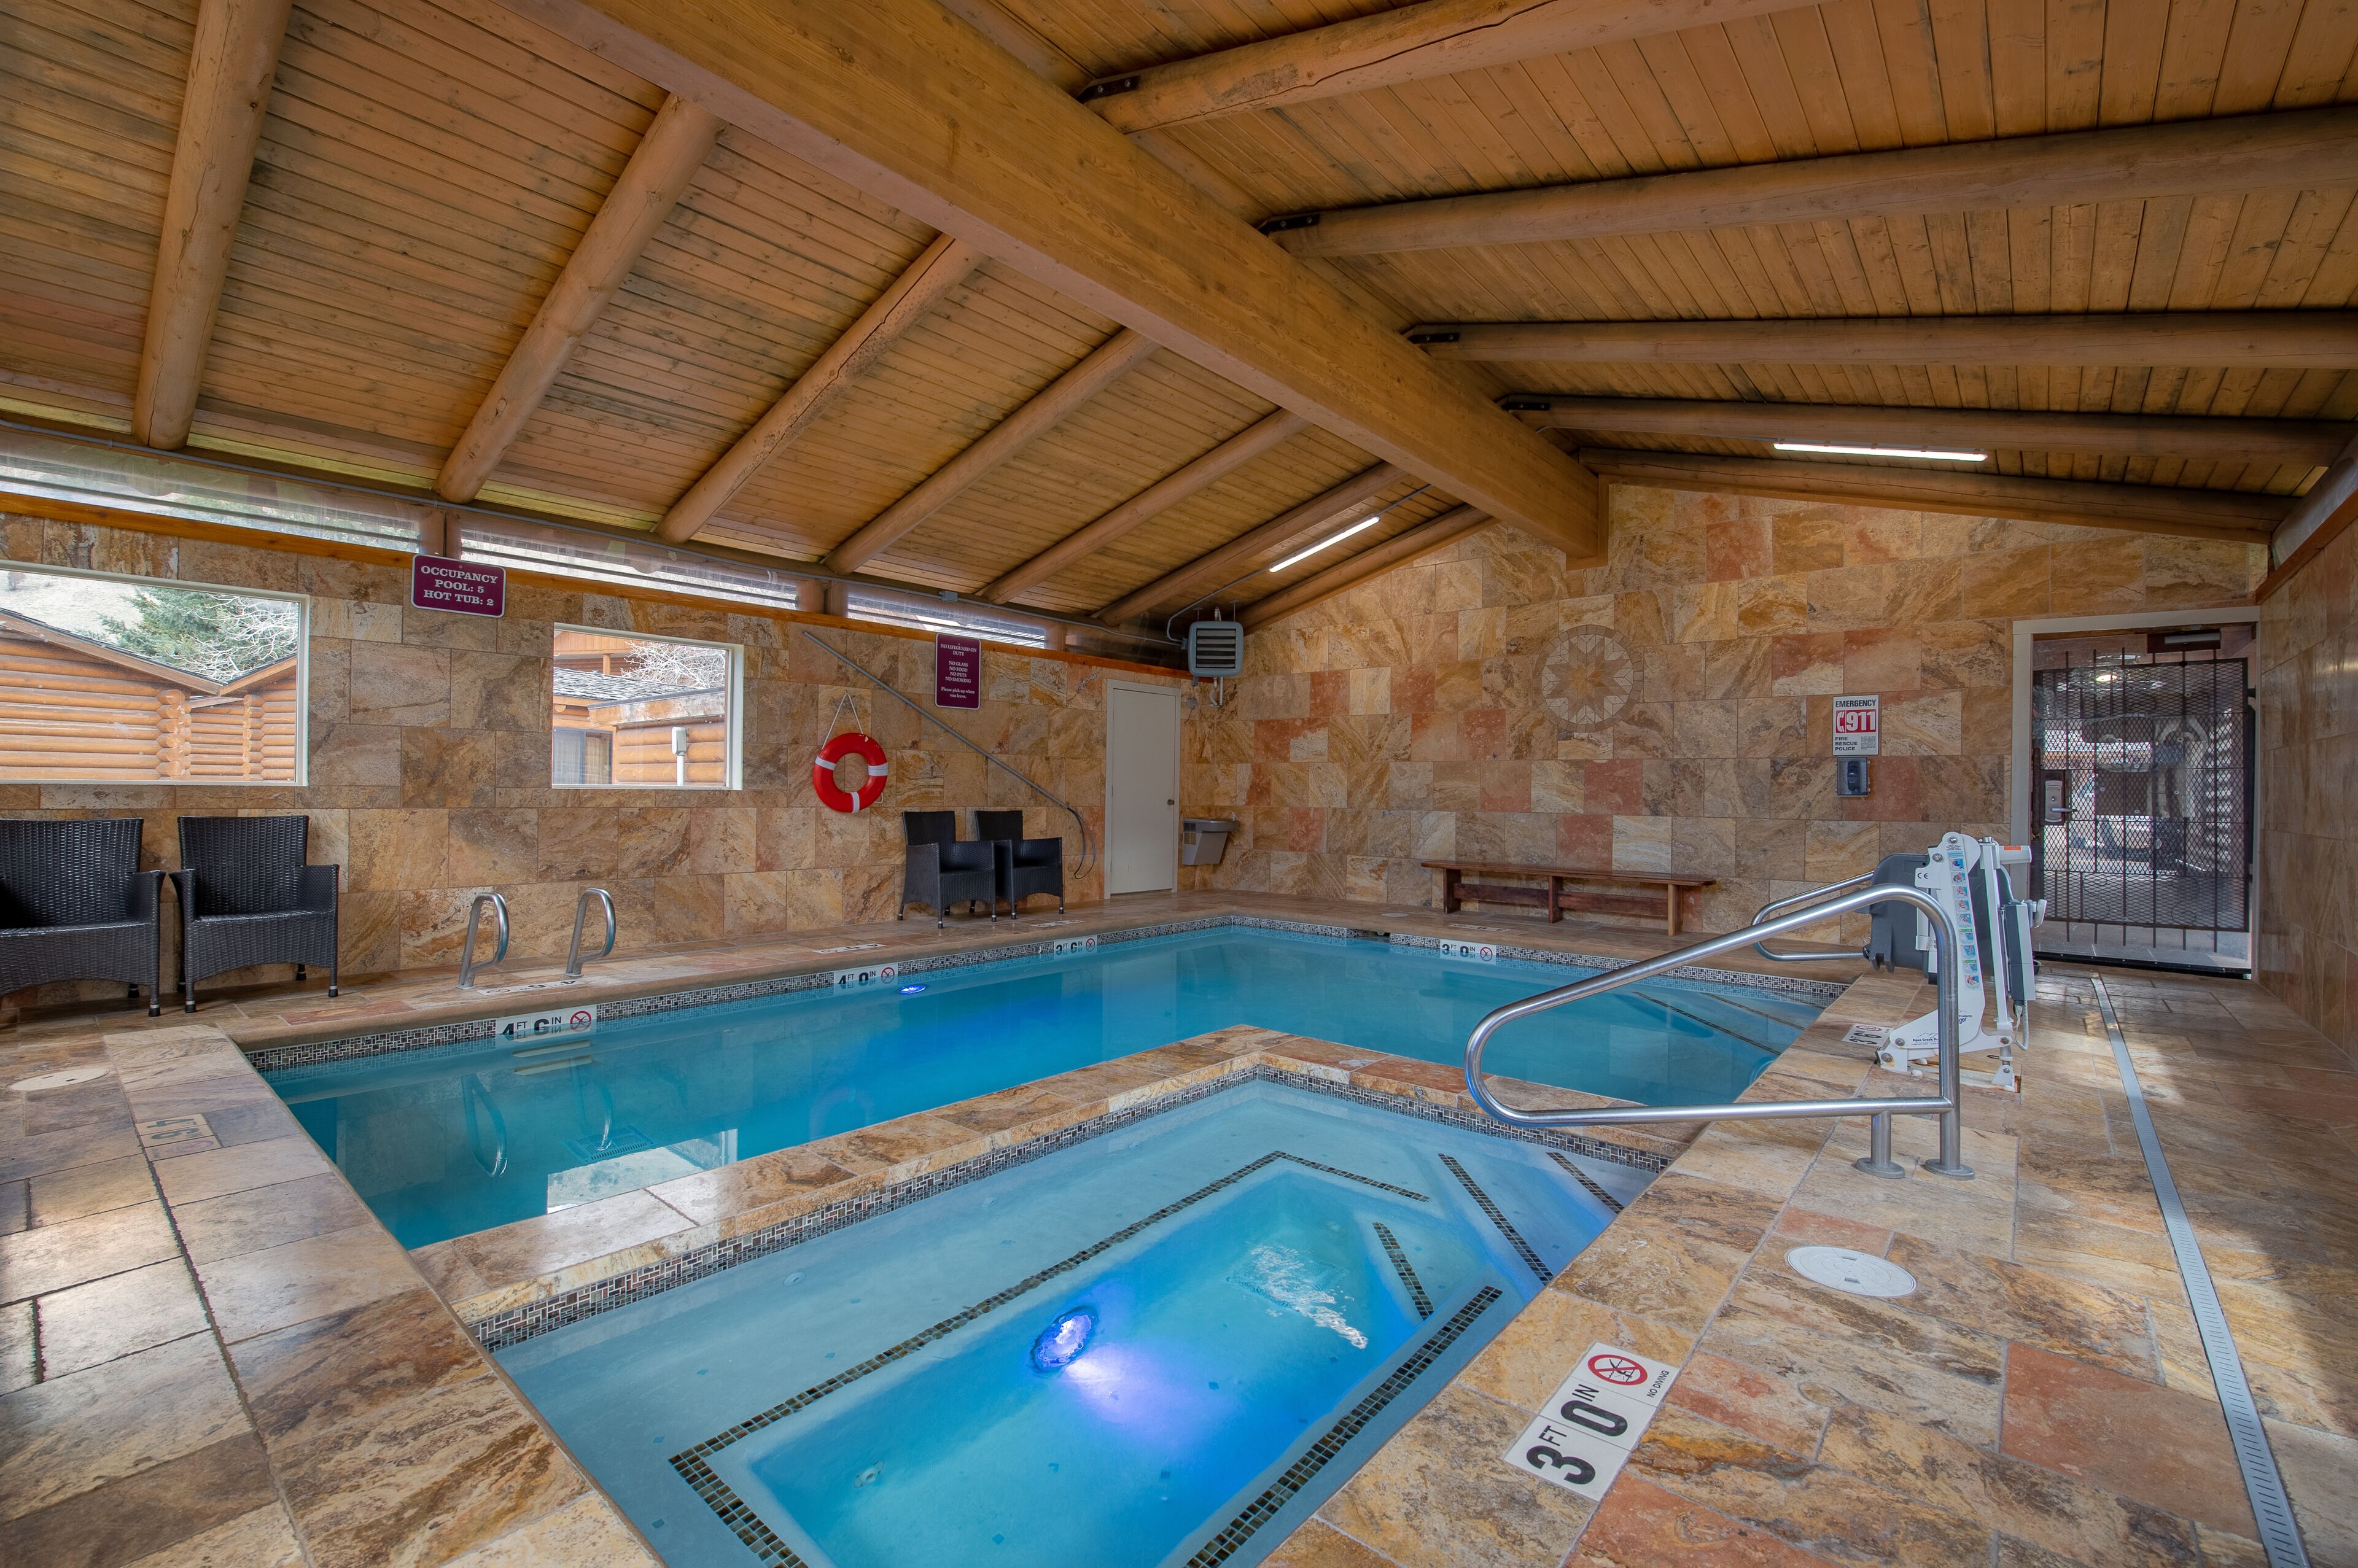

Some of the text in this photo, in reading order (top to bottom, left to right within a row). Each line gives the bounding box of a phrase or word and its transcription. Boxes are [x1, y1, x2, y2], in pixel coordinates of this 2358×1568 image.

[421, 565, 498, 583] OCCUPANCY
[435, 580, 473, 592] POOL:
[423, 589, 451, 600] HOT
[454, 594, 483, 604] TUB:
[1846, 712, 1875, 731] 911
[517, 1021, 527, 1030] FT
[147, 1119, 194, 1128] 4
[151, 1128, 200, 1139] 6
[1646, 1370, 1670, 1398] NO DIVING
[1526, 1384, 1628, 1485] 3 FT 0 IN
